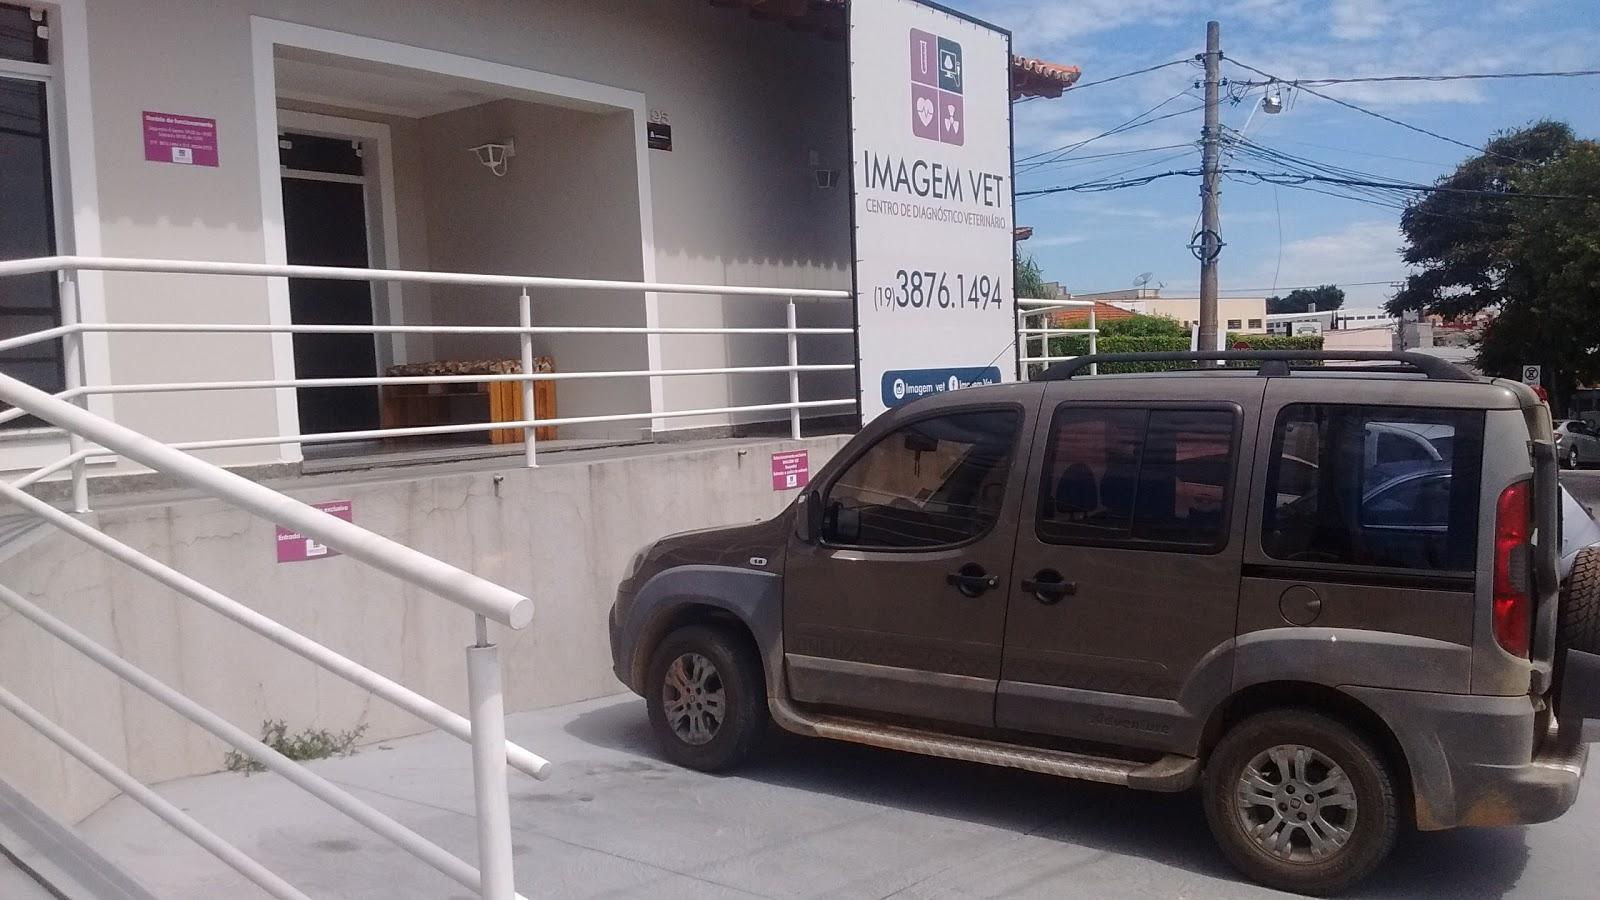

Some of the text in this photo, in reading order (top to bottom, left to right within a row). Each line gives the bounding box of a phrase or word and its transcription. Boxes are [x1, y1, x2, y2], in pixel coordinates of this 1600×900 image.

[864, 150, 1003, 208] IMAGEM VET
[866, 198, 1006, 230] CENTRO DE DIAGNÓSTICO VETERINÁRIO
[906, 383, 933, 396] Imagem
[935, 382, 945, 392] vet
